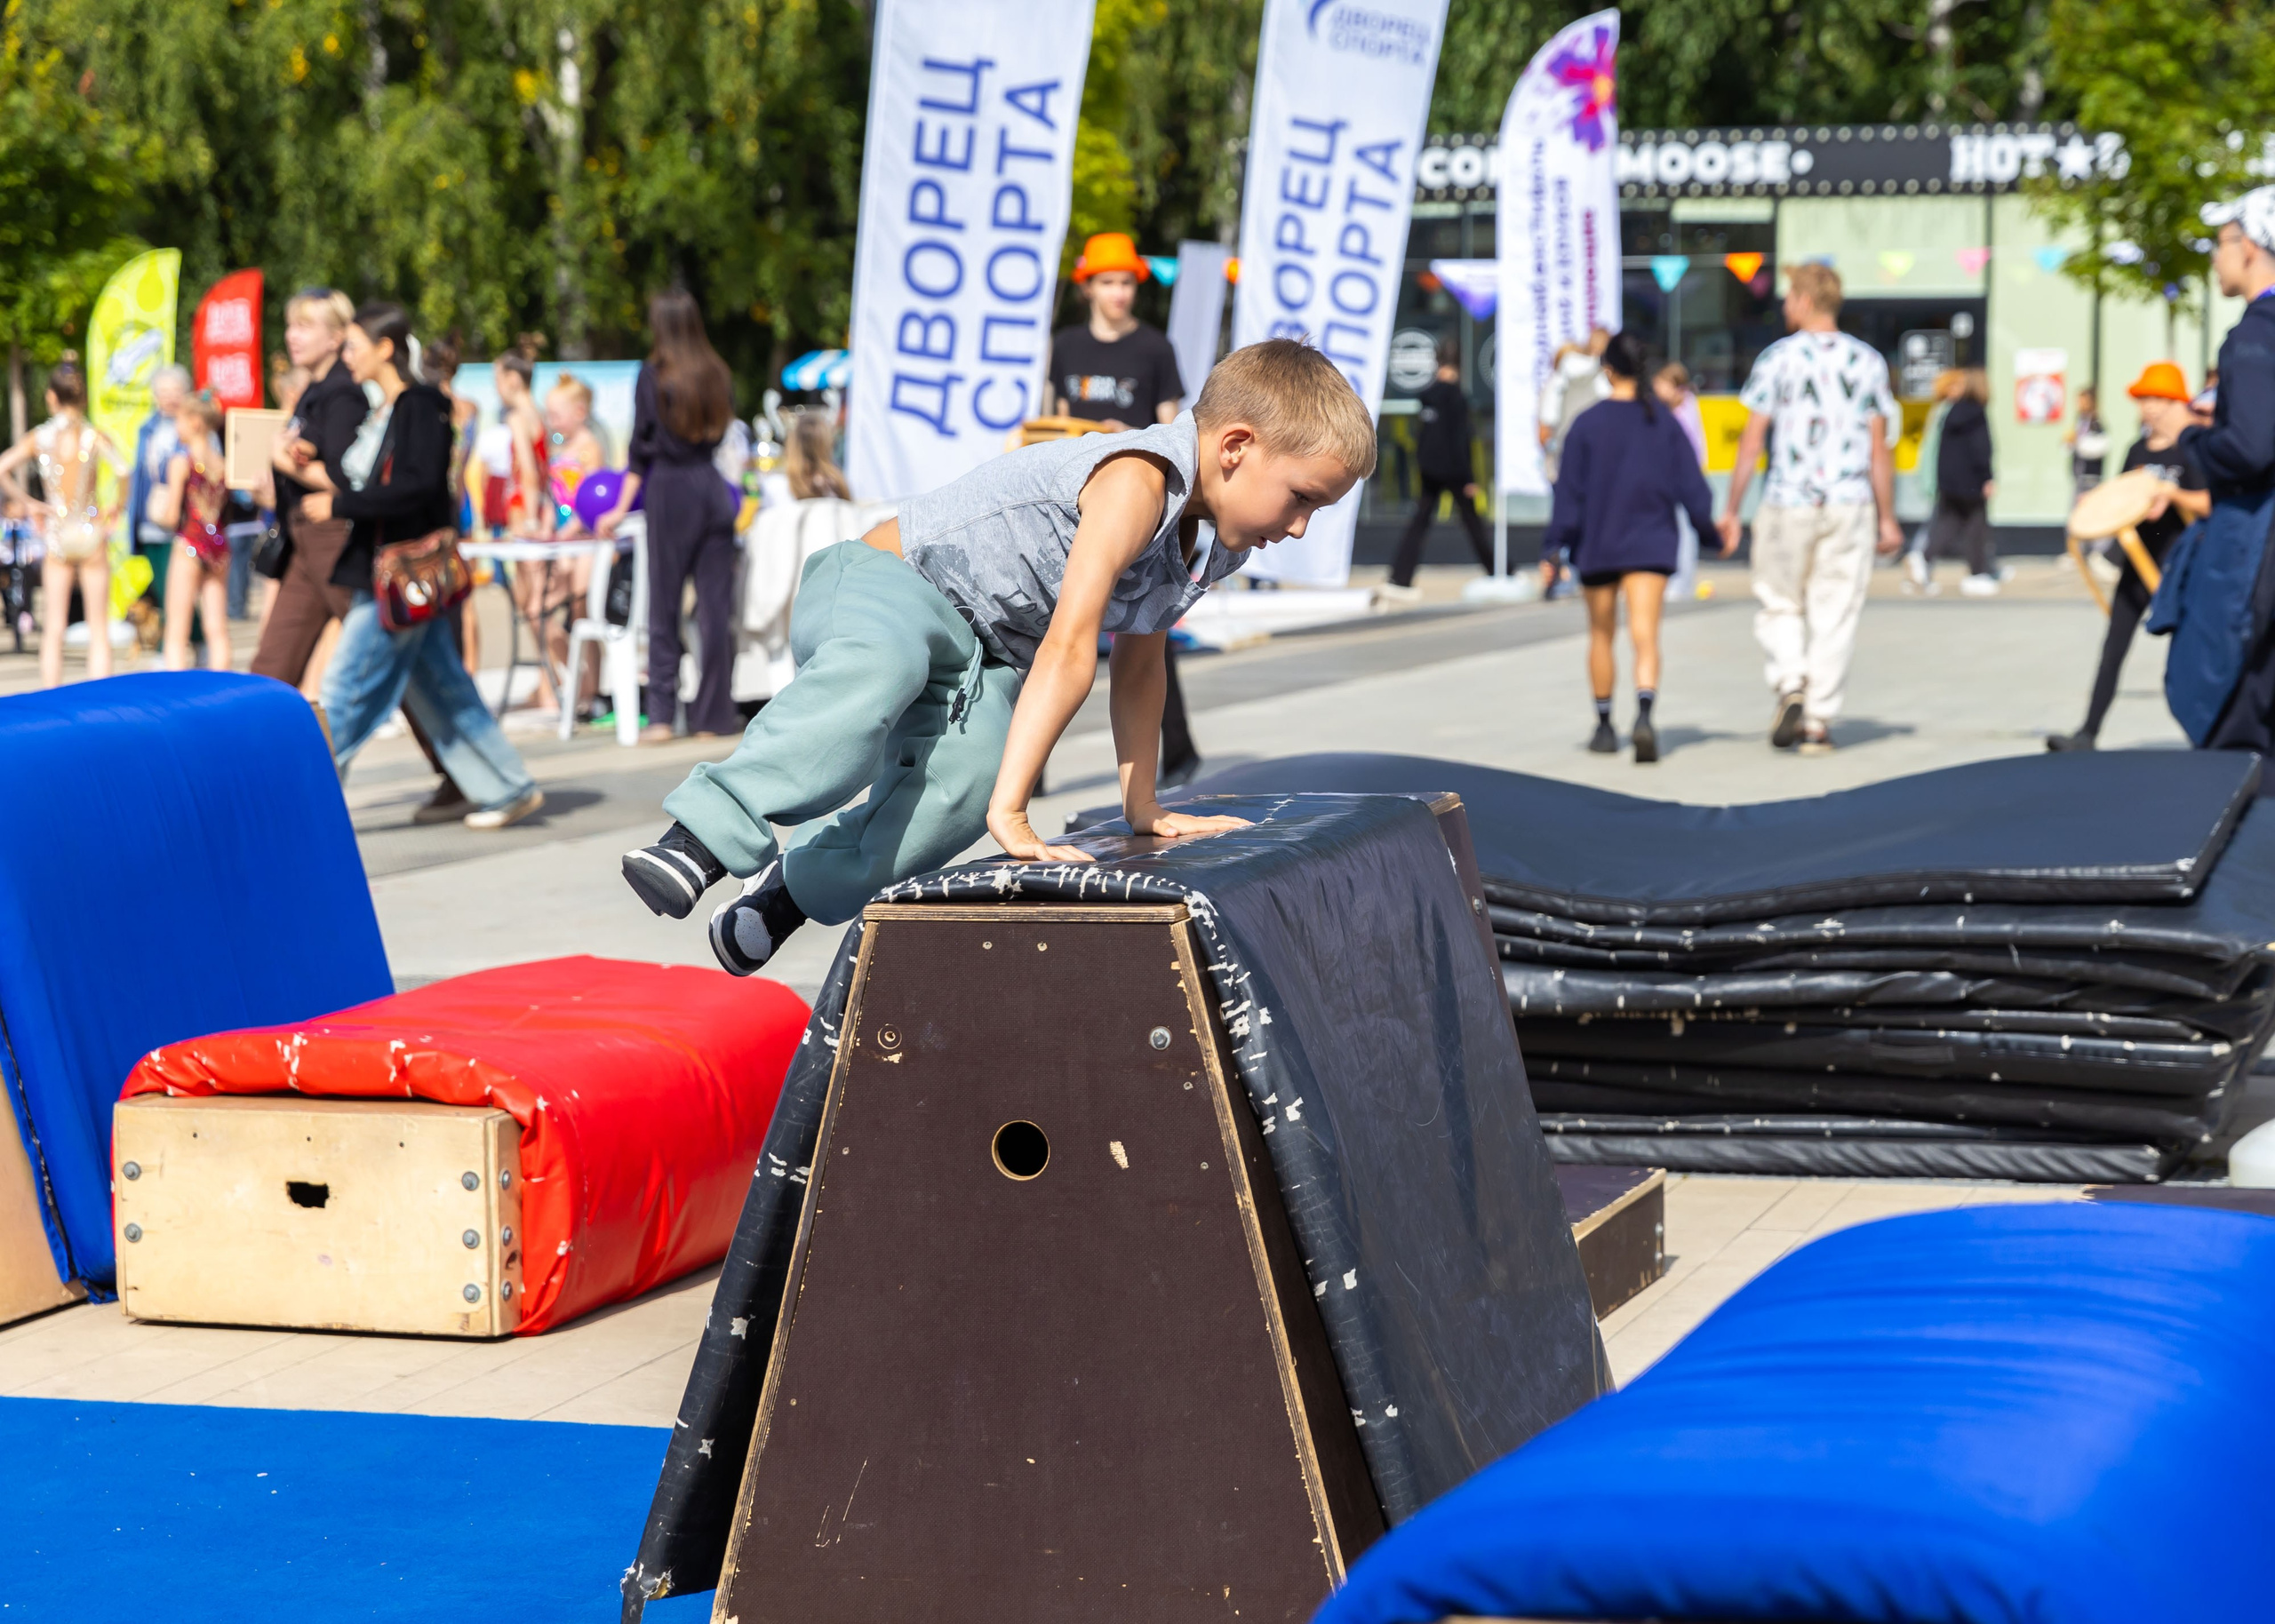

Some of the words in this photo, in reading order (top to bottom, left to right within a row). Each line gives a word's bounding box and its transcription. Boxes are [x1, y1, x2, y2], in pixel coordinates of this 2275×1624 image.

[890, 56, 996, 438] ДВОРЕЦ
[972, 77, 1061, 431] СПОРТА
[1321, 139, 1403, 397] ПОРТА
[1616, 140, 1791, 185] MOOSE
[1949, 133, 2056, 182] HOT
